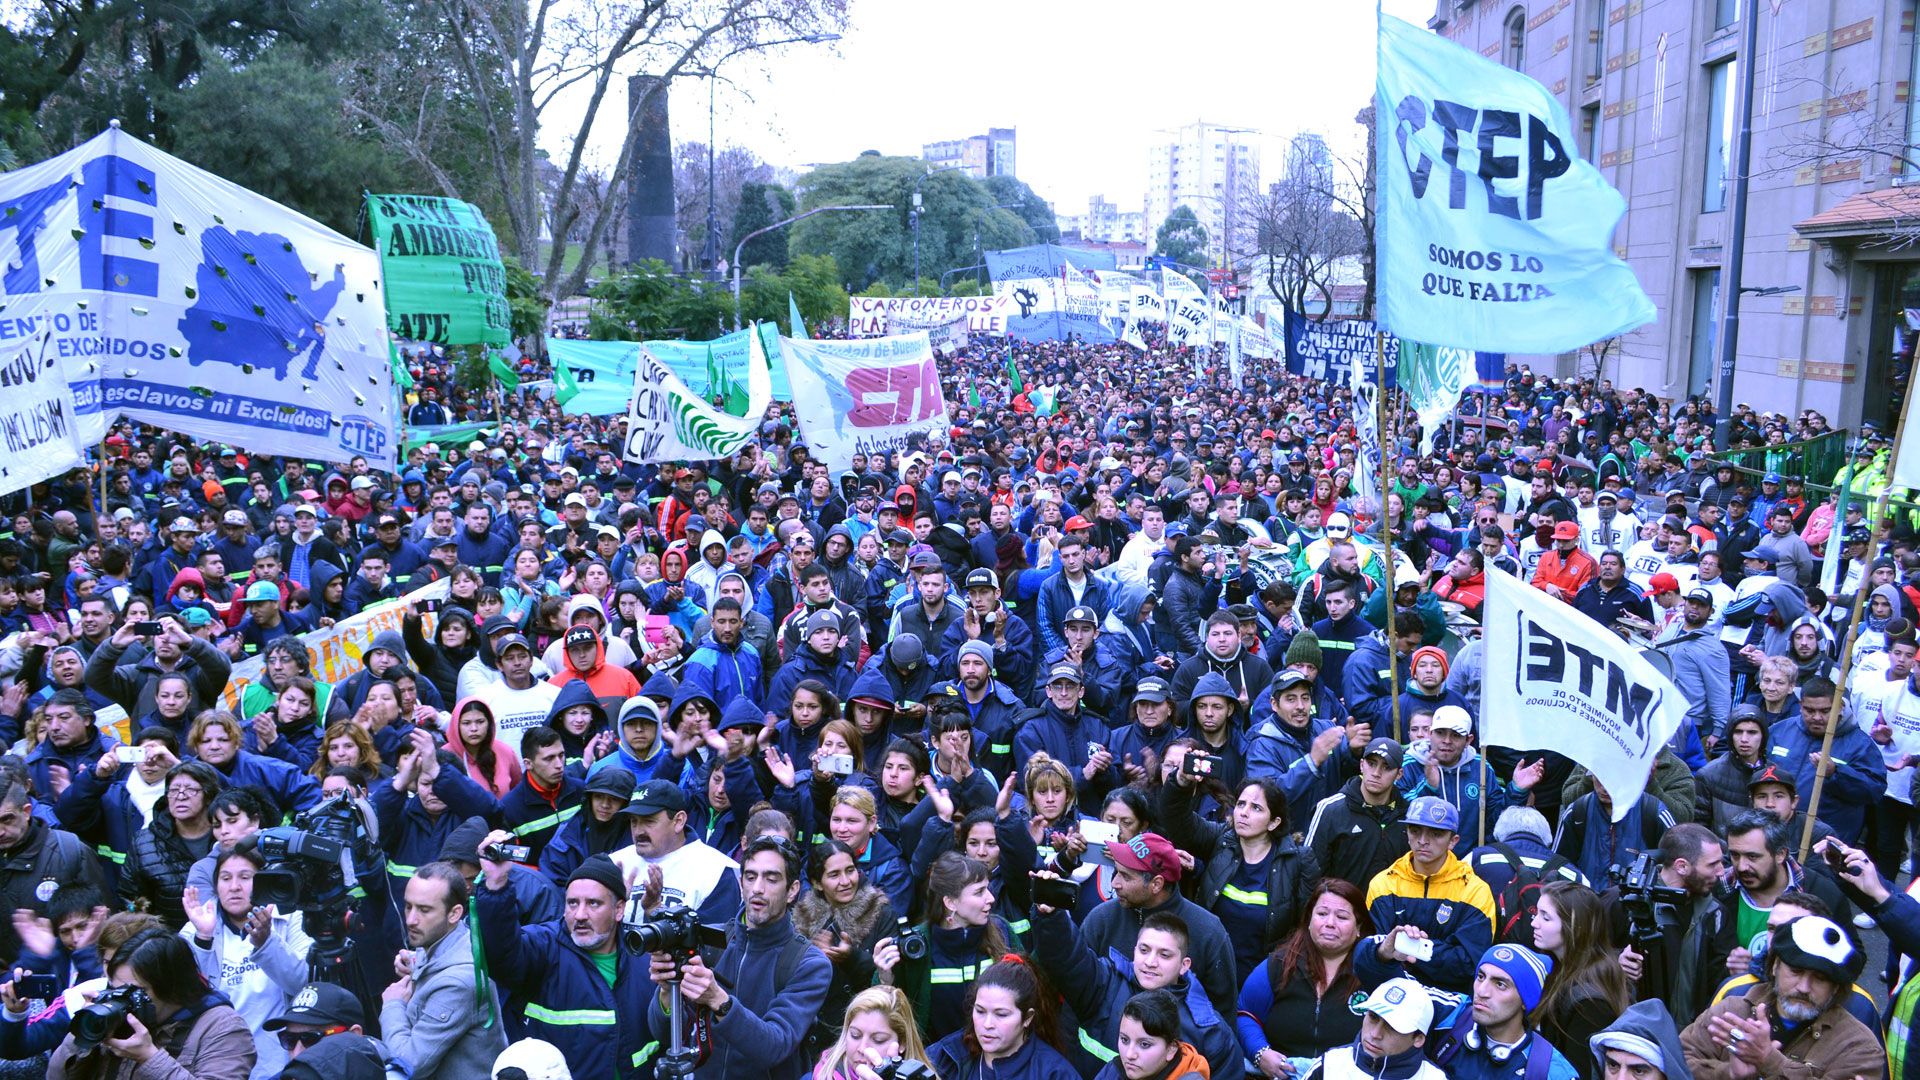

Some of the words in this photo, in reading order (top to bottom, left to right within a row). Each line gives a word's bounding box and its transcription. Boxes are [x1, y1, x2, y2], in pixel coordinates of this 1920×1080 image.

[1395, 95, 1571, 220] CTEP
[1429, 243, 1502, 271] SOMOS
[1510, 254, 1543, 273] LO
[1422, 273, 1464, 297] QUE
[1469, 282, 1555, 302] FALTA
[79, 313, 98, 331] DE
[397, 313, 450, 344] ATE
[816, 343, 870, 359] Ciudad
[874, 342, 890, 359] de
[106, 386, 204, 410] esclavos
[211, 399, 231, 415] ni
[845, 359, 944, 428] CTA
[340, 420, 387, 455] CTEP
[856, 436, 870, 456] de
[871, 434, 887, 453] los
[1592, 532, 1621, 544] CTP
[500, 715, 545, 724] CARTONEROS
